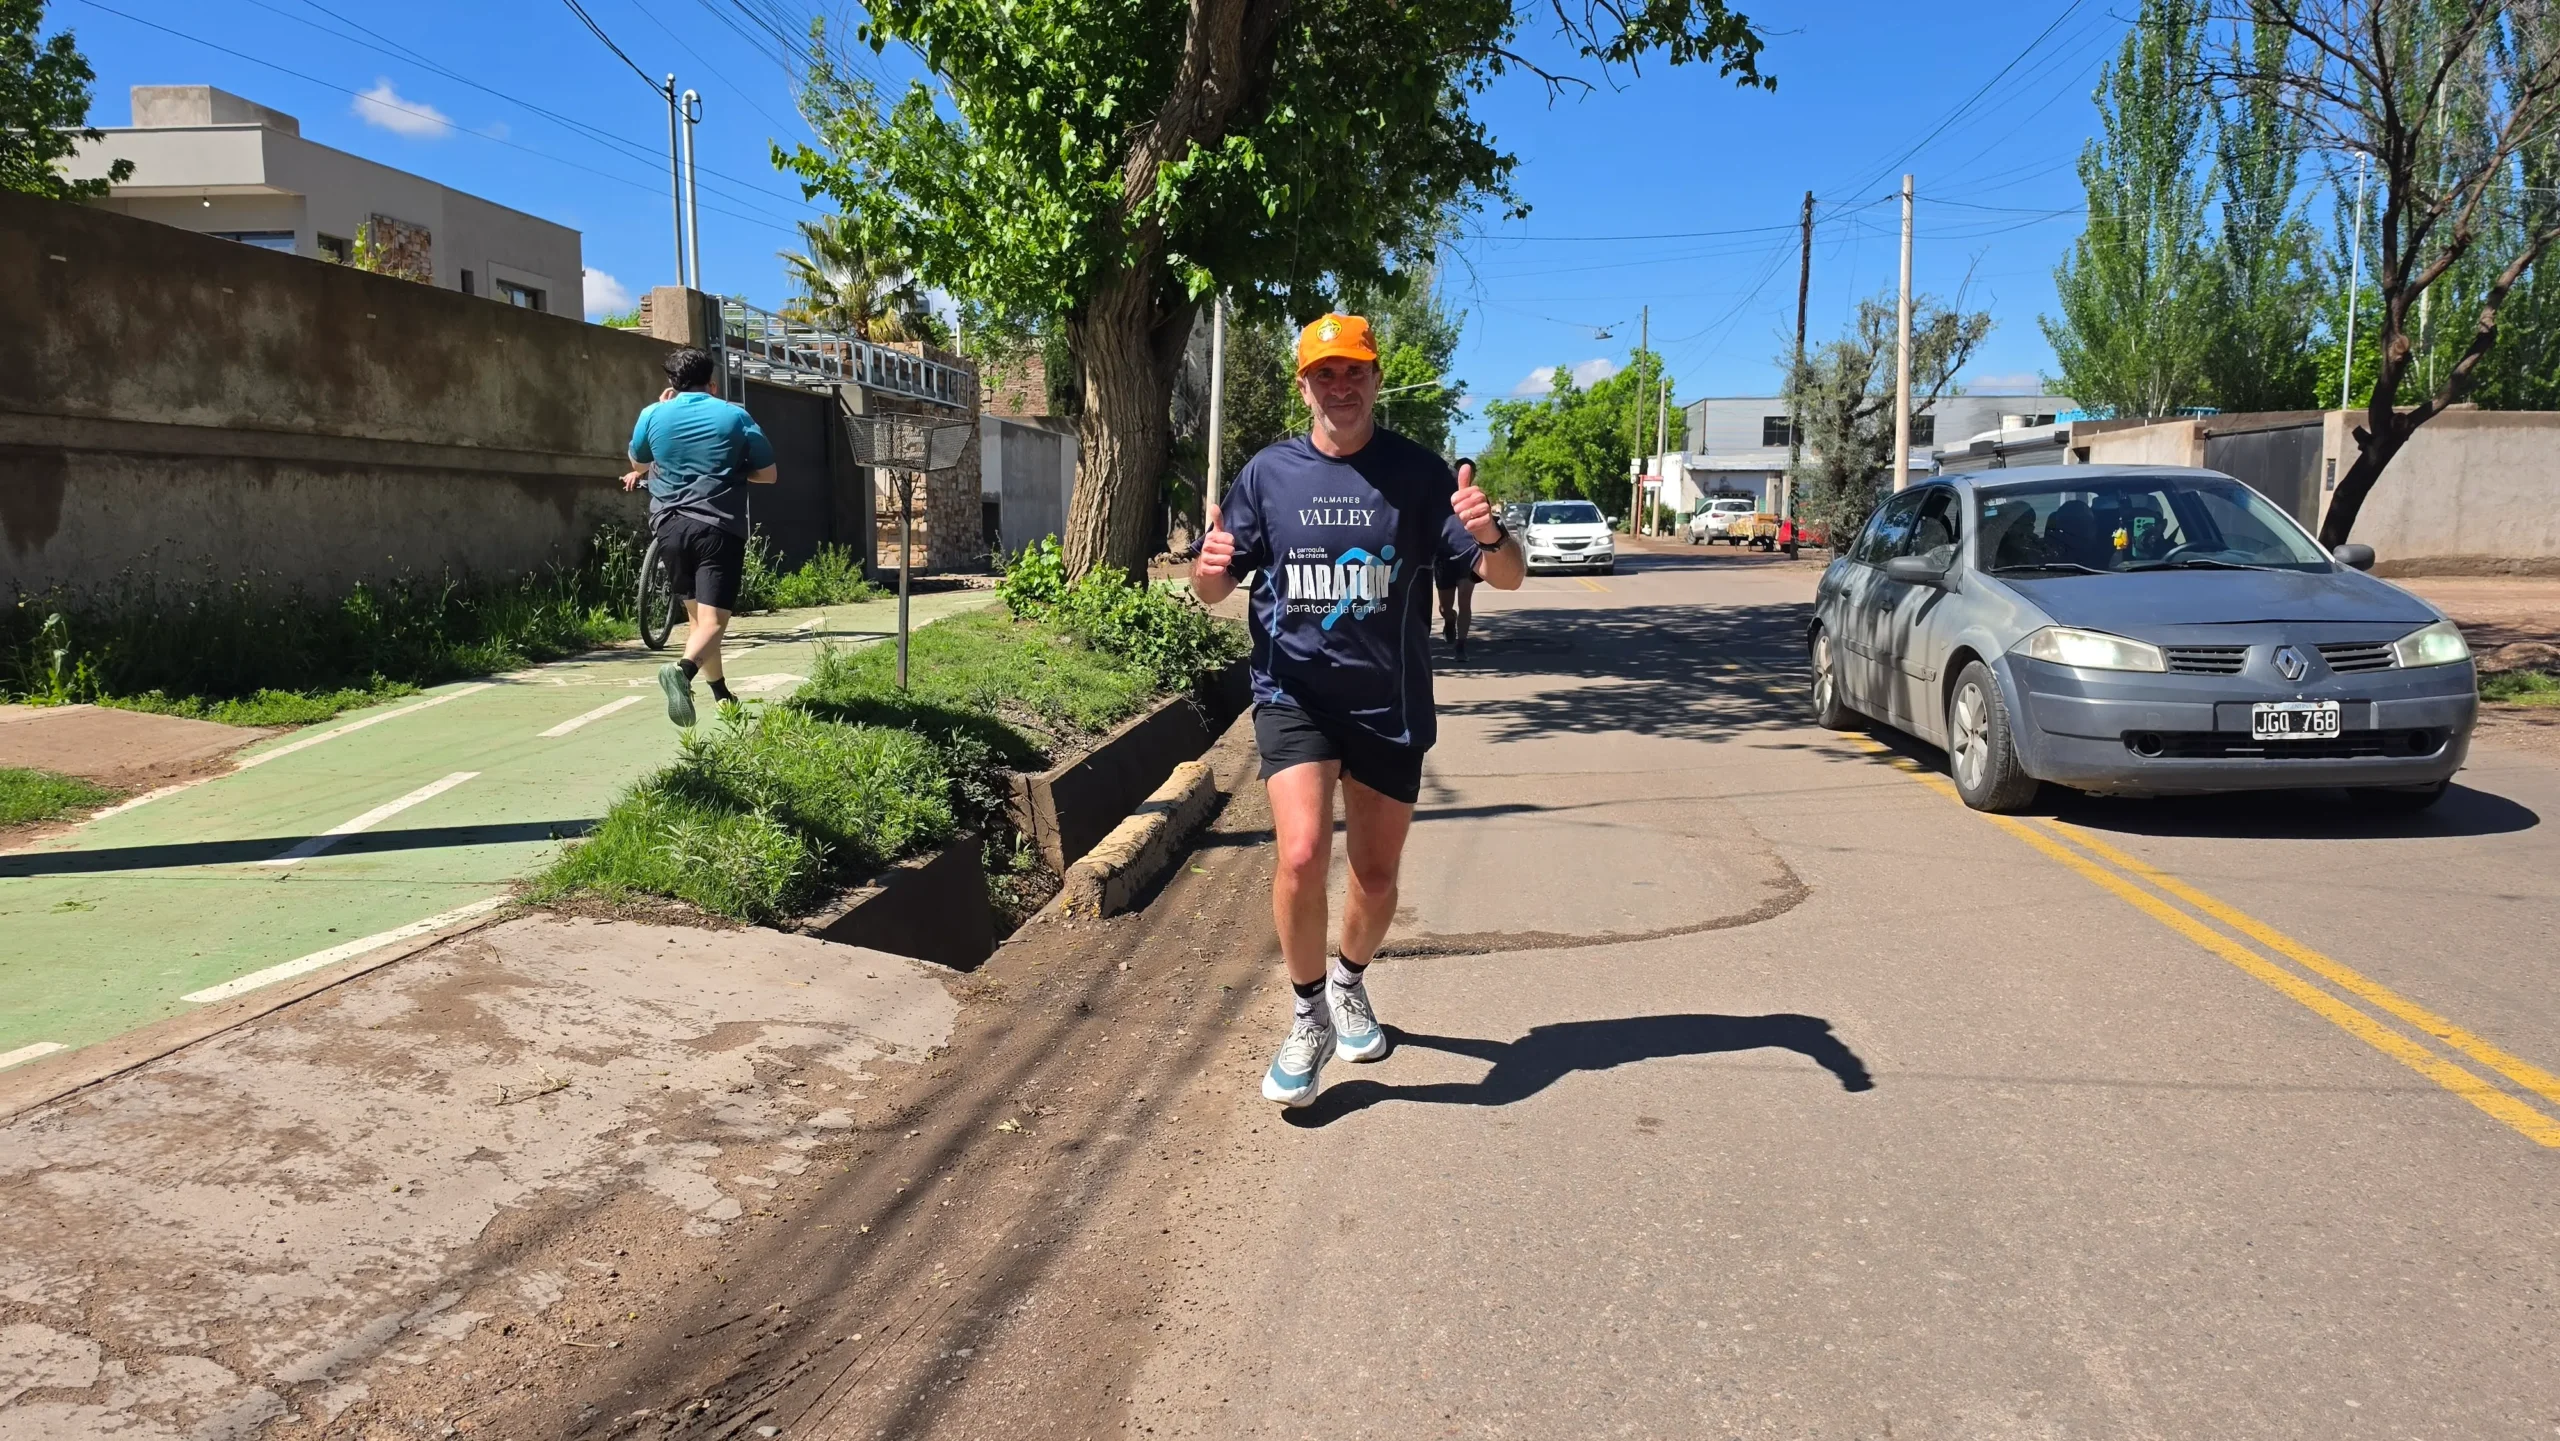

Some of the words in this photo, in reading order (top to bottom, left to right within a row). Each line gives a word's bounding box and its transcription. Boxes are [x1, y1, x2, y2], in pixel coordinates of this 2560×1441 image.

[1312, 496, 1360, 504] PALMARES
[1299, 508, 1375, 526] VALLEY
[1286, 604, 1311, 615] para
[1311, 603, 1338, 614] toda
[1340, 603, 1349, 614] la
[2301, 711, 2336, 731] 768
